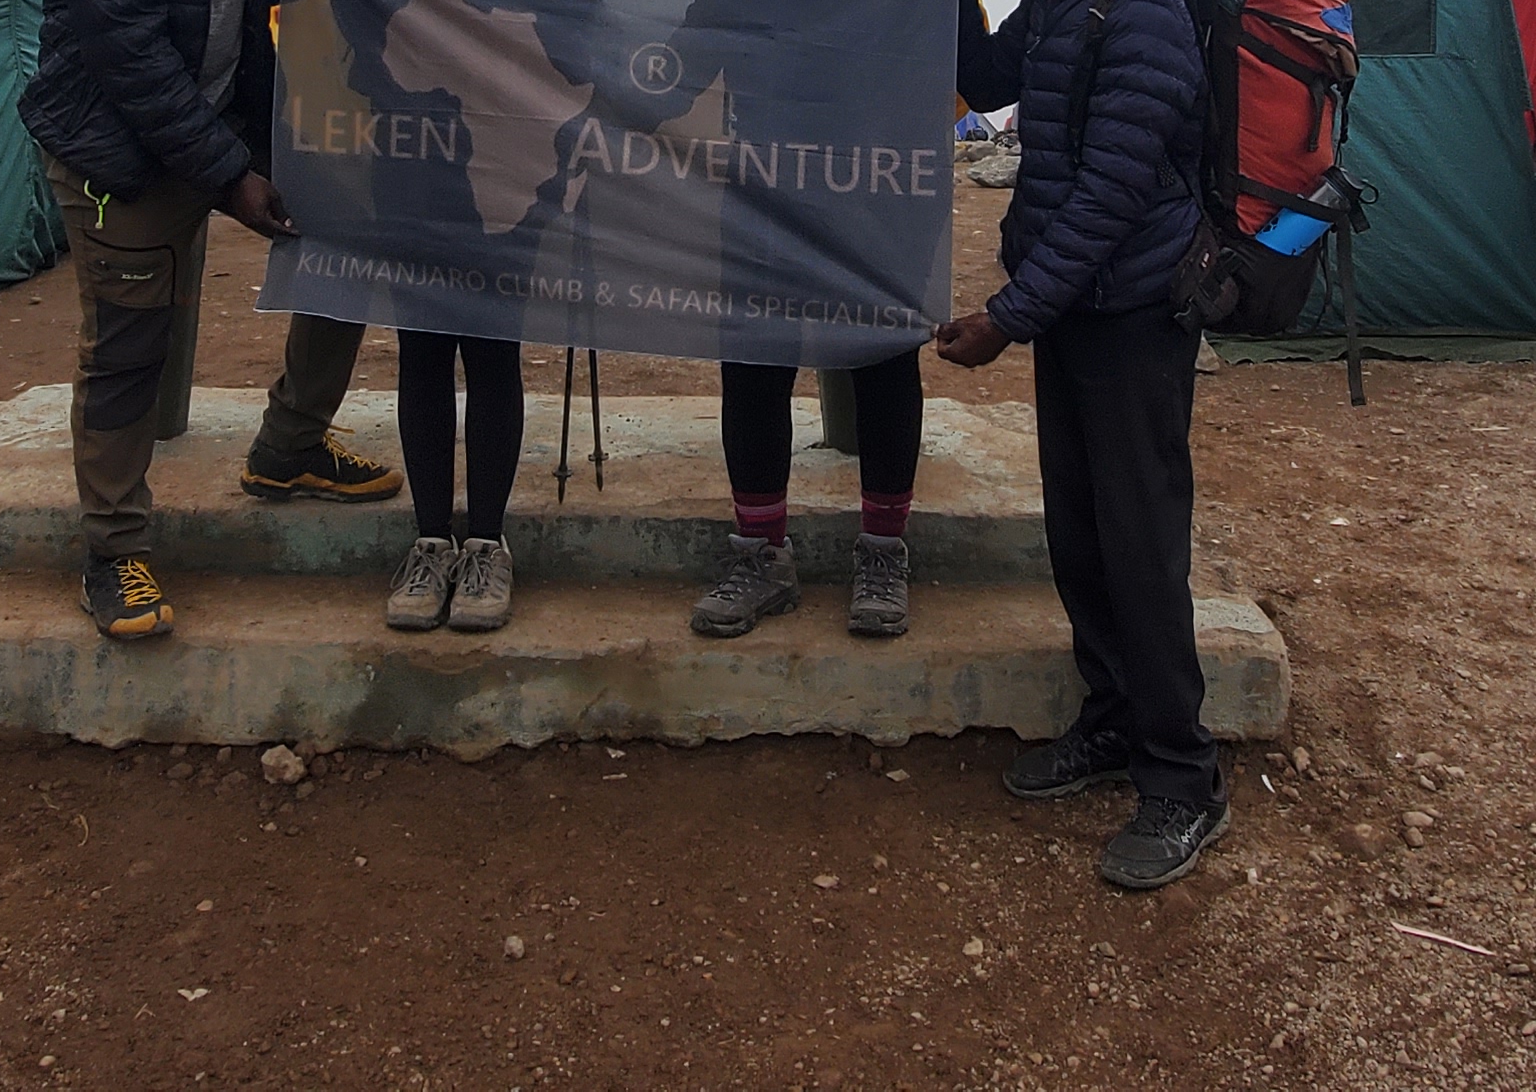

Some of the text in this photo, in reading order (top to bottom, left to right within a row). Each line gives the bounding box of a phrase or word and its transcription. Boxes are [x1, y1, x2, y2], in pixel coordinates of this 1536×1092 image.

[292, 96, 938, 197] LEKEN ADVENTURE
[295, 251, 918, 331] KILIMANJARO CLIMB & SAFARI SPECIALIST
